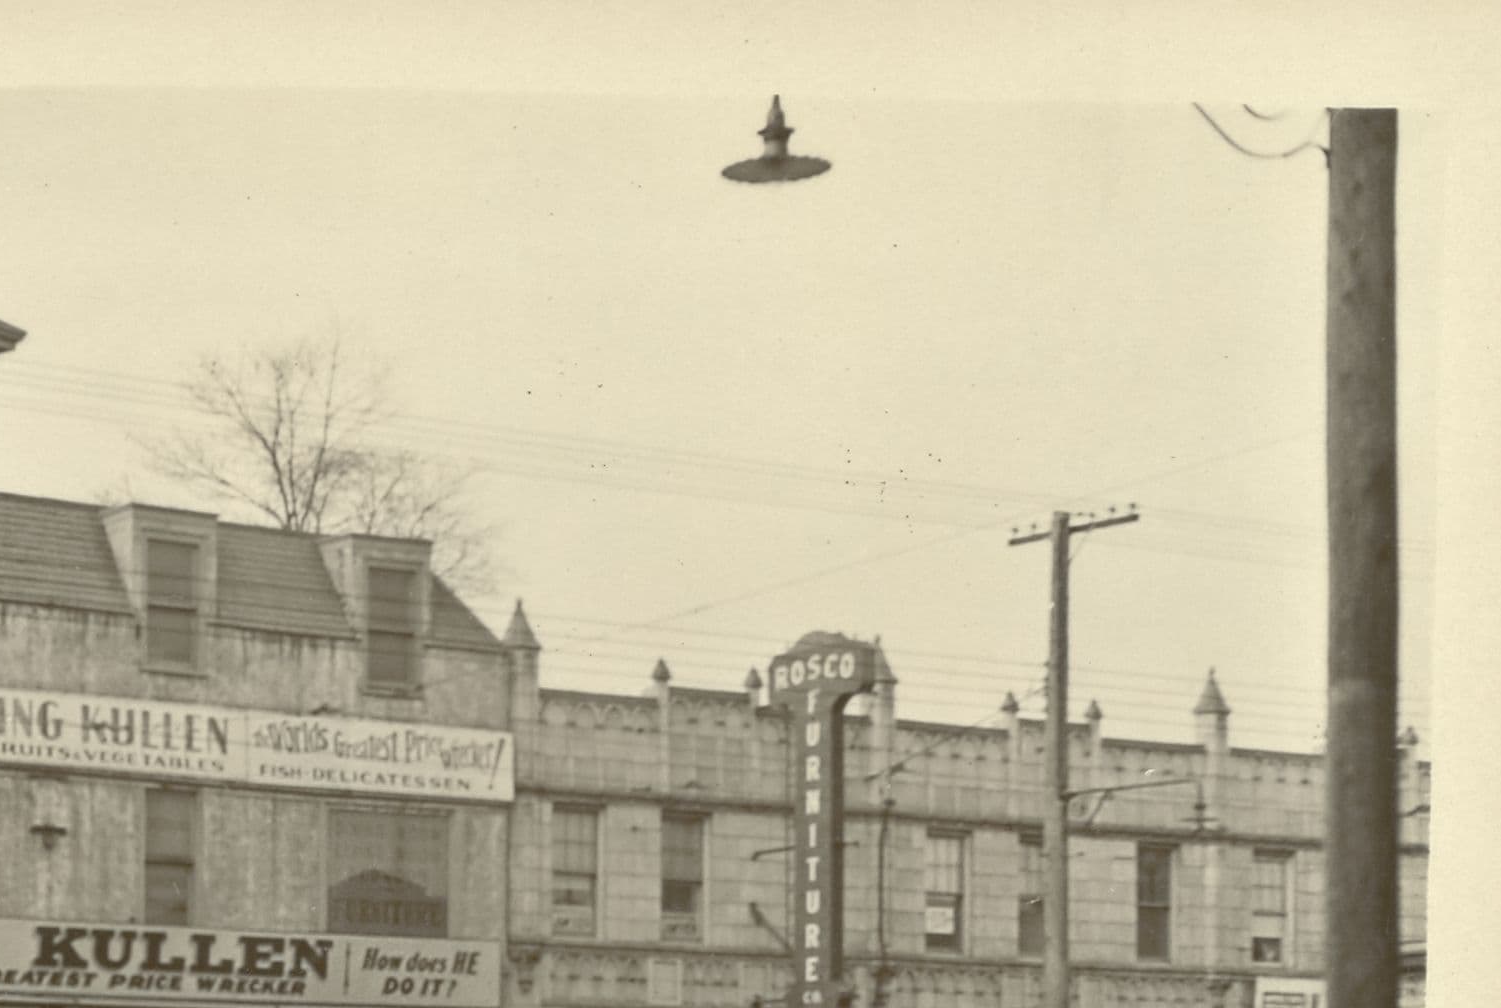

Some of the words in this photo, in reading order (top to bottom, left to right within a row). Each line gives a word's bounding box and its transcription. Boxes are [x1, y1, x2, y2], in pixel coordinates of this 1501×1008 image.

[774, 652, 854, 691] ROSCO
[81, 703, 229, 756] KULLEN
[804, 690, 821, 982] FURNITURE
[33, 926, 334, 981] KULLEN
[362, 947, 404, 971] How
[405, 949, 449, 975] does
[452, 950, 481, 976] HE
[107, 970, 183, 992] PRICE
[196, 977, 307, 996] WRECKER
[381, 978, 414, 997] DO
